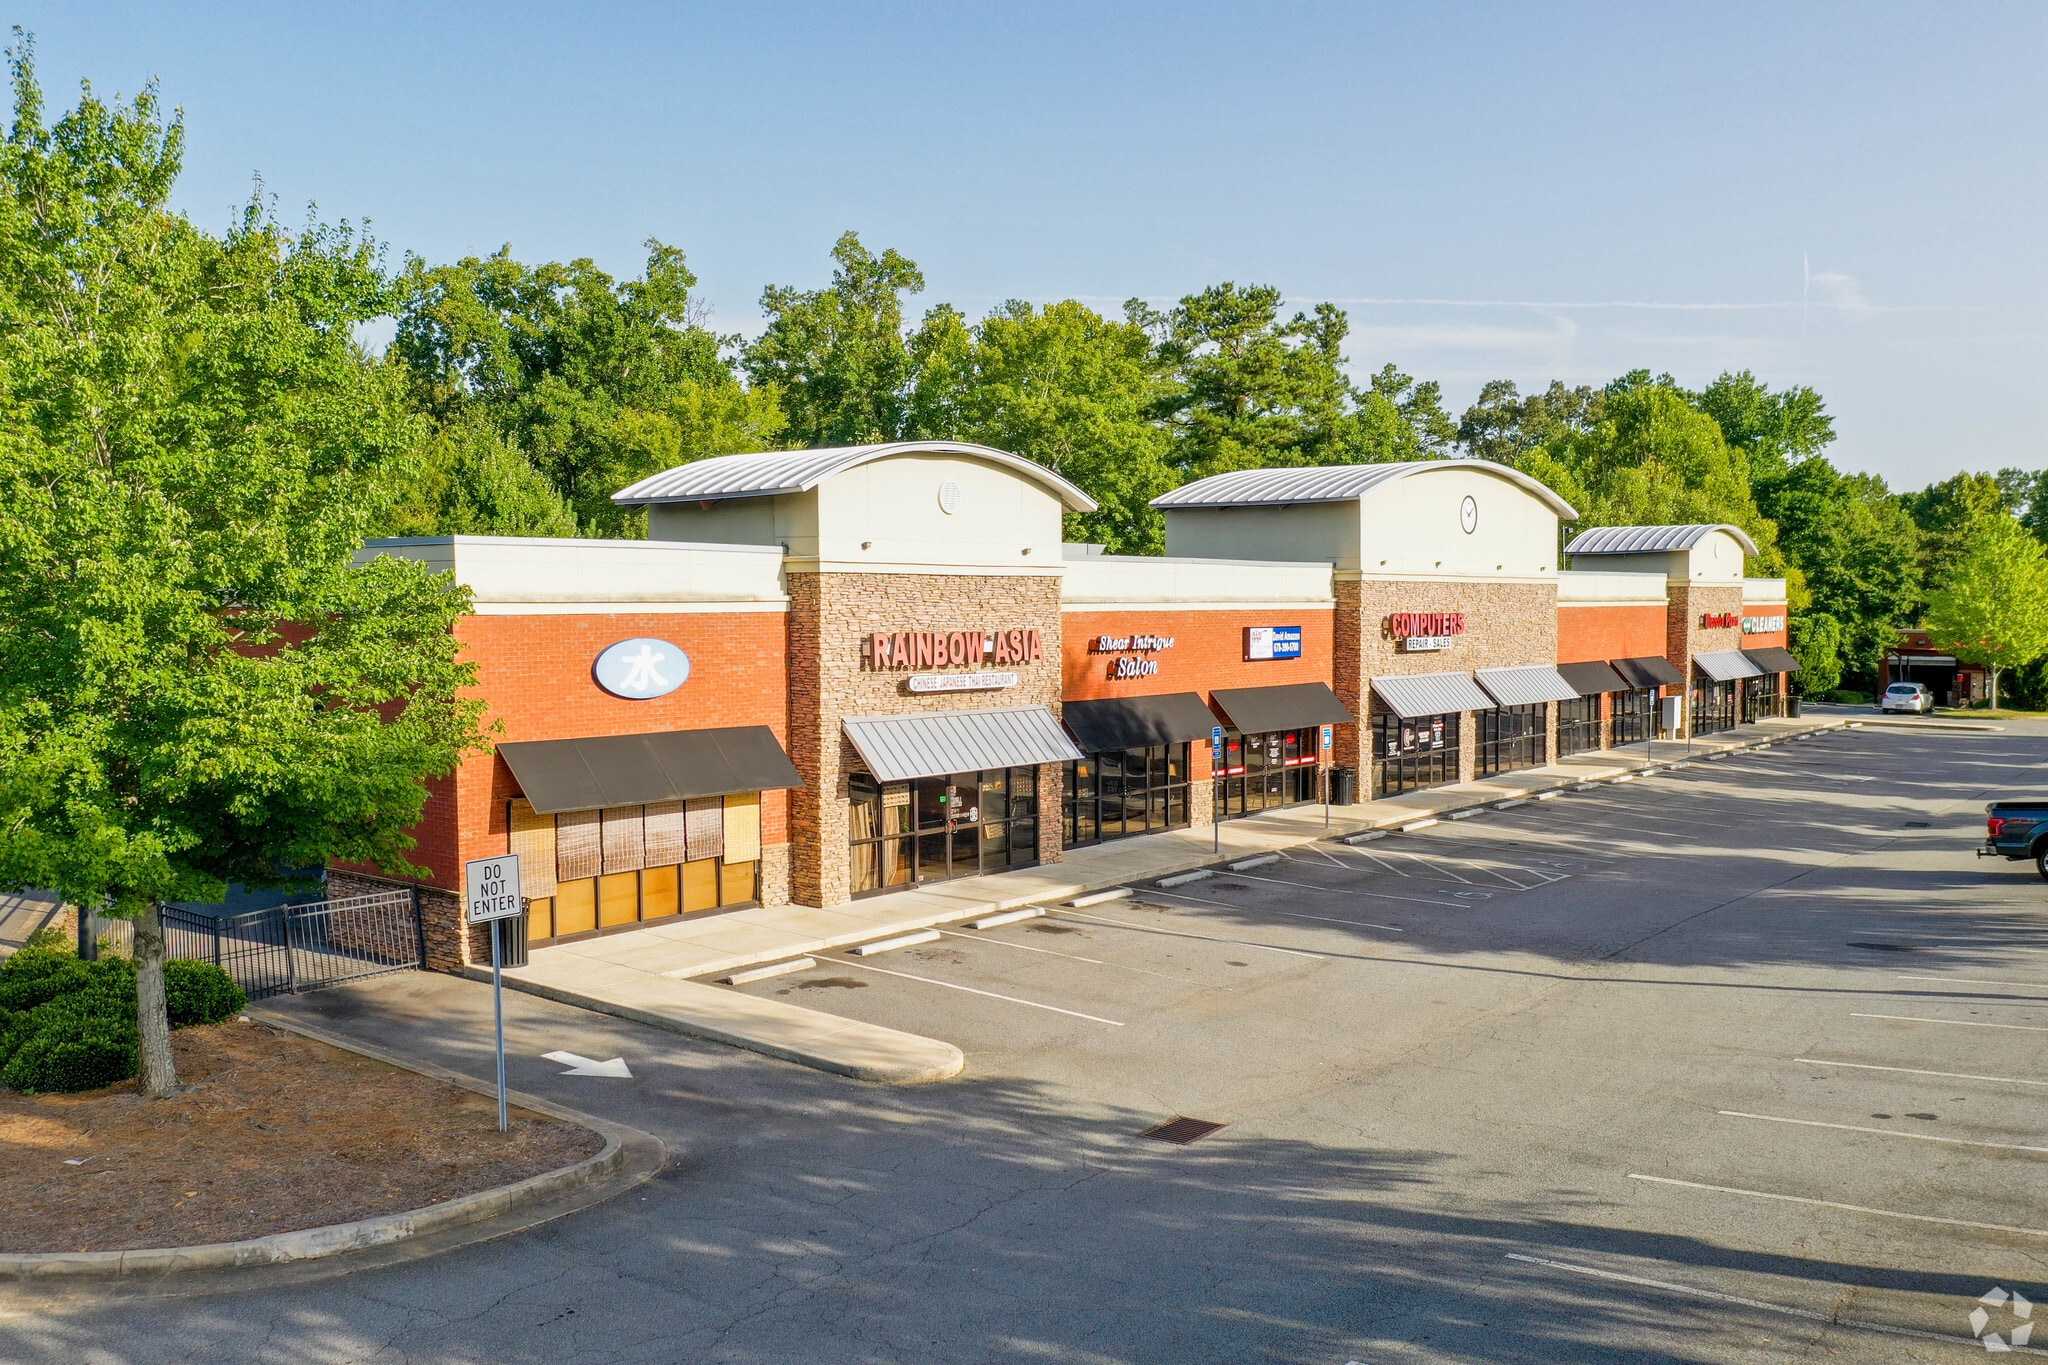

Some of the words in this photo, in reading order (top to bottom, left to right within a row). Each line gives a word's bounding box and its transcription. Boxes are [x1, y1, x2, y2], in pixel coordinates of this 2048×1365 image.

[1392, 612, 1465, 637] COMPUTERS
[1751, 616, 1784, 633] CLEANERS
[872, 631, 986, 668] RAINBOW
[994, 629, 1045, 663] ASIA
[1099, 635, 1131, 651] Shear
[1132, 634, 1175, 652] Intrigue
[1408, 638, 1429, 649] REPAIR
[1433, 638, 1450, 648] SALES
[619, 644, 669, 691] 水
[1117, 656, 1158, 677] Salon
[913, 677, 937, 690] CHINESE
[940, 675, 967, 689] JAPANESE
[969, 674, 980, 687] THAI
[981, 673, 1015, 687] RESTAURANT
[484, 864, 501, 880] DO
[481, 880, 506, 897] NOT
[474, 895, 515, 916] ENTER
